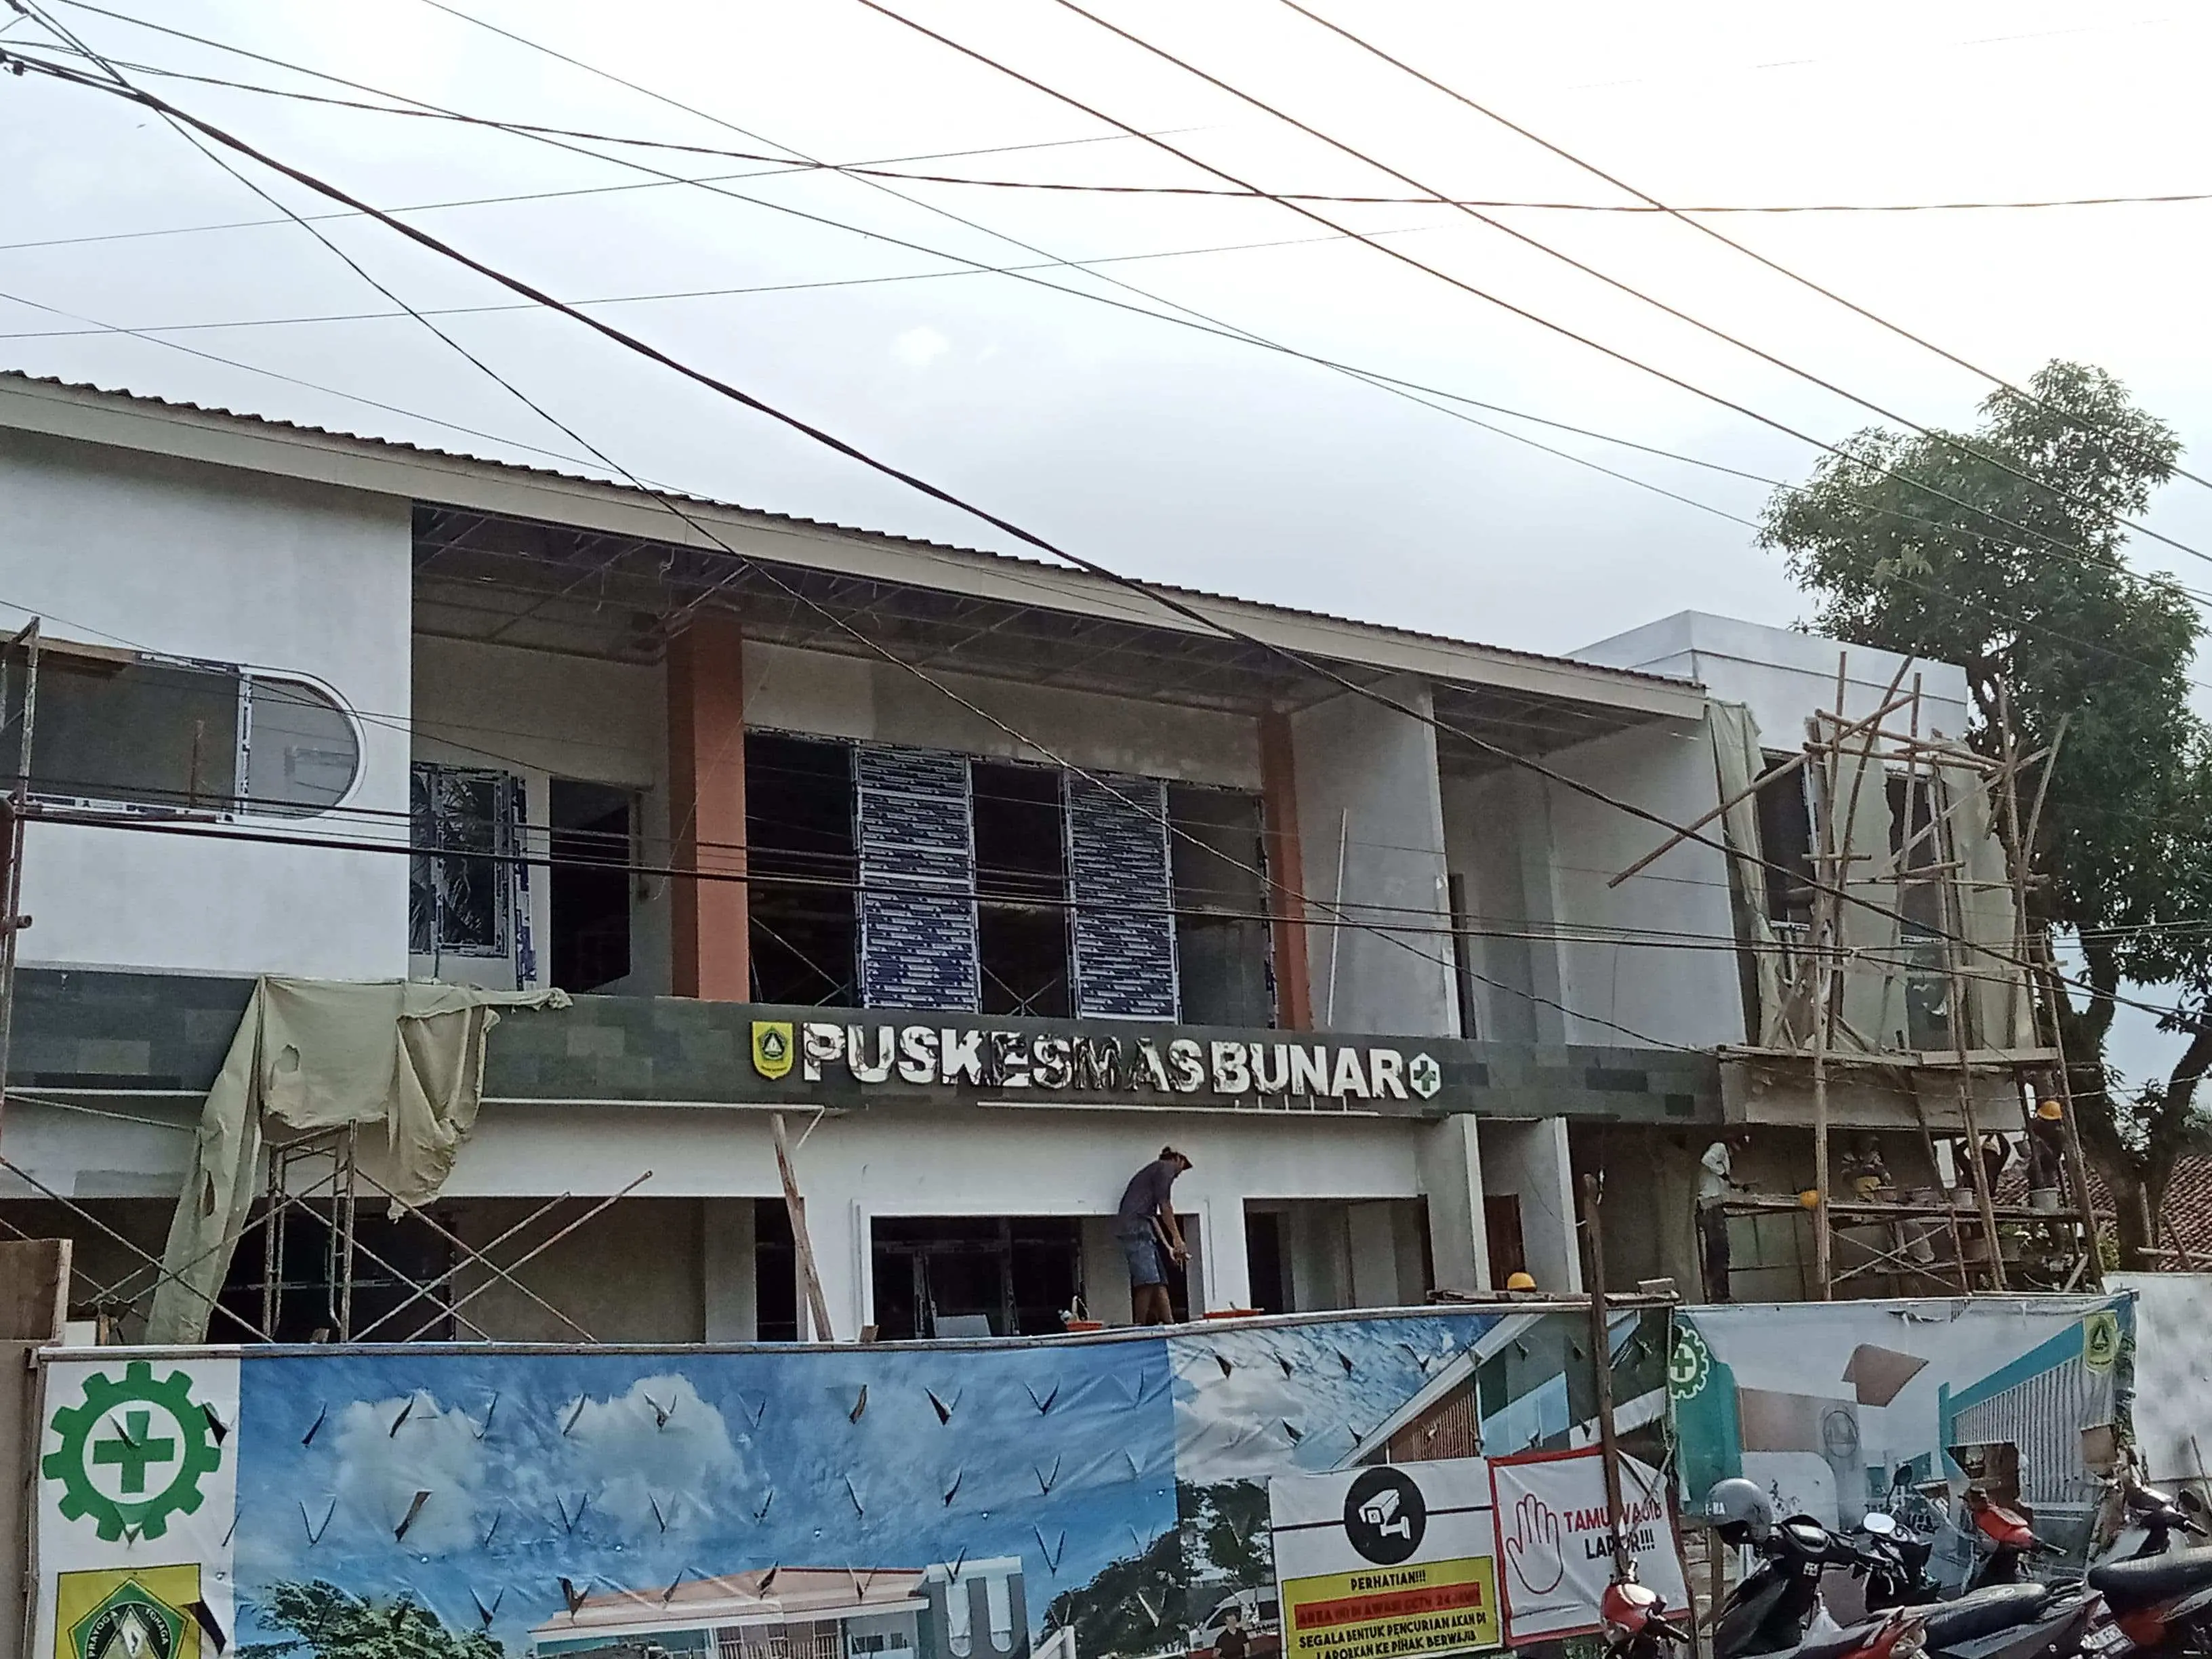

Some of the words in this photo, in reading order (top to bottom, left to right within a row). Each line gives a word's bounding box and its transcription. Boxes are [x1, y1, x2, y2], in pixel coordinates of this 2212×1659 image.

[802, 1022, 1205, 1092] PUSKESMAS
[1211, 1040, 1409, 1099] BUNAR
[1563, 1505, 1611, 1533] TAMU
[1351, 1570, 1426, 1591] PERHATIAN!!!
[1299, 1631, 1345, 1649] SEGALA
[1346, 1624, 1385, 1643] BENTUK
[1387, 1616, 1450, 1637] PENCURIAN
[1452, 1612, 1475, 1628] AKAN
[1476, 1612, 1487, 1624] DI
[1375, 1641, 1390, 1655] KE
[1391, 1637, 1425, 1652] PIHAK
[1425, 1629, 1477, 1648] BERWAJIB
